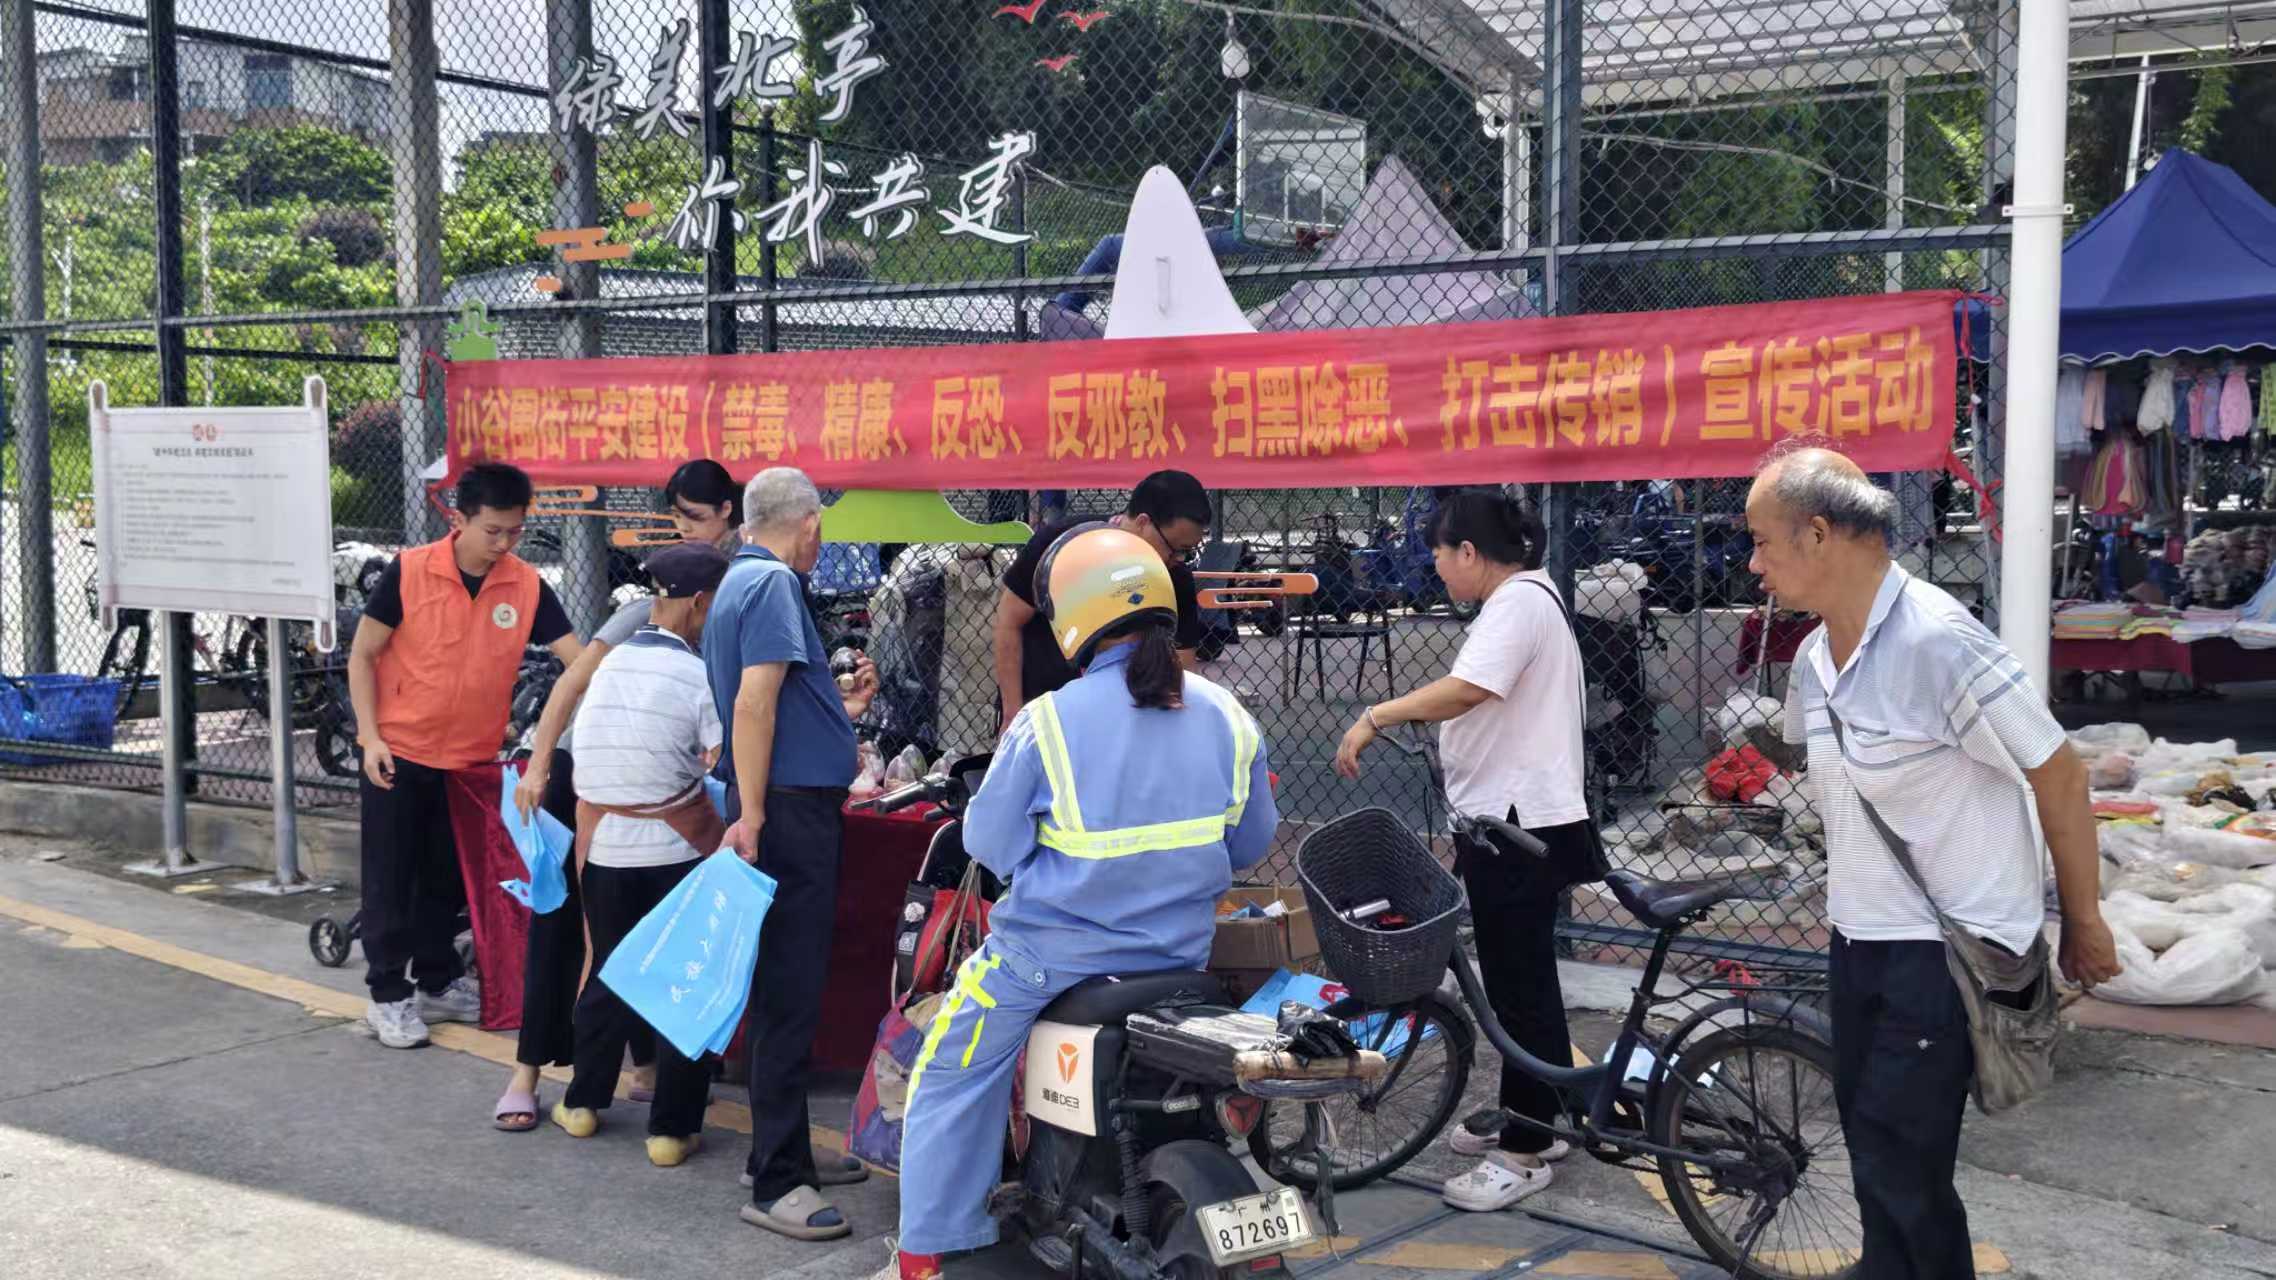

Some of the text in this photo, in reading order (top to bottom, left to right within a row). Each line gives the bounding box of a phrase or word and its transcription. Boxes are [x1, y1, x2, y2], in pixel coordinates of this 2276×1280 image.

[555, 4, 887, 140] 绿美北亭
[664, 130, 1040, 267] 你我共建
[1219, 1212, 1301, 1250] 872697
